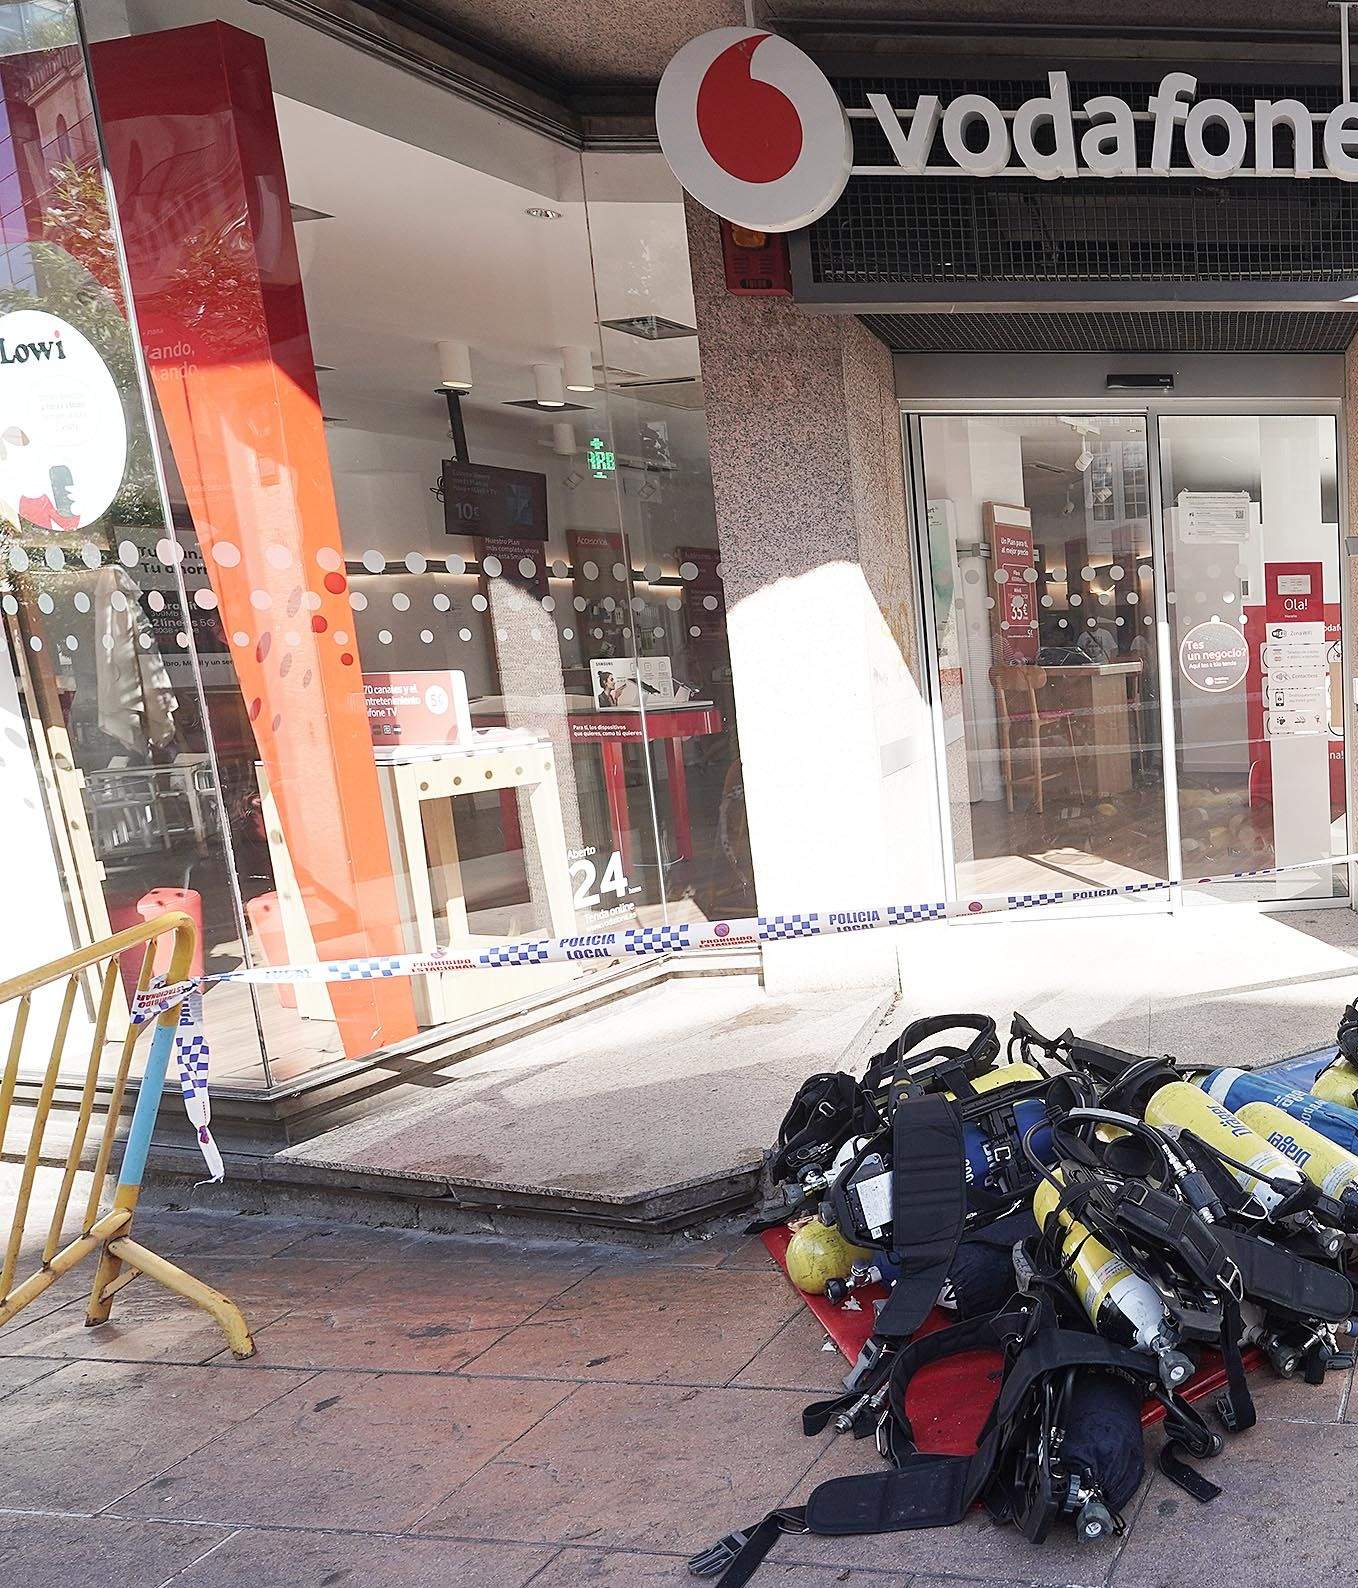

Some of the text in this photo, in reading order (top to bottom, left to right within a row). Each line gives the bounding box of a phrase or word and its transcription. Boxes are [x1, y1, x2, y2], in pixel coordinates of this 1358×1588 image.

[0, 330, 66, 364] Lowi
[141, 562, 160, 573] Tu
[1284, 598, 1308, 611] Ola!
[1187, 647, 1247, 661] un negocio?
[568, 850, 629, 911] 24
[1072, 886, 1119, 900] POLICIA
[828, 910, 880, 925] POLICIA
[559, 933, 616, 948] POLICIA
[700, 935, 753, 945] PROHIBIDO
[566, 947, 612, 960] LOCAL
[411, 964, 477, 973] ESTACIONAR
[412, 958, 471, 967] PROHIBIDO
[1207, 1104, 1253, 1138] Dräger
[1267, 1131, 1313, 1169] Dräger
